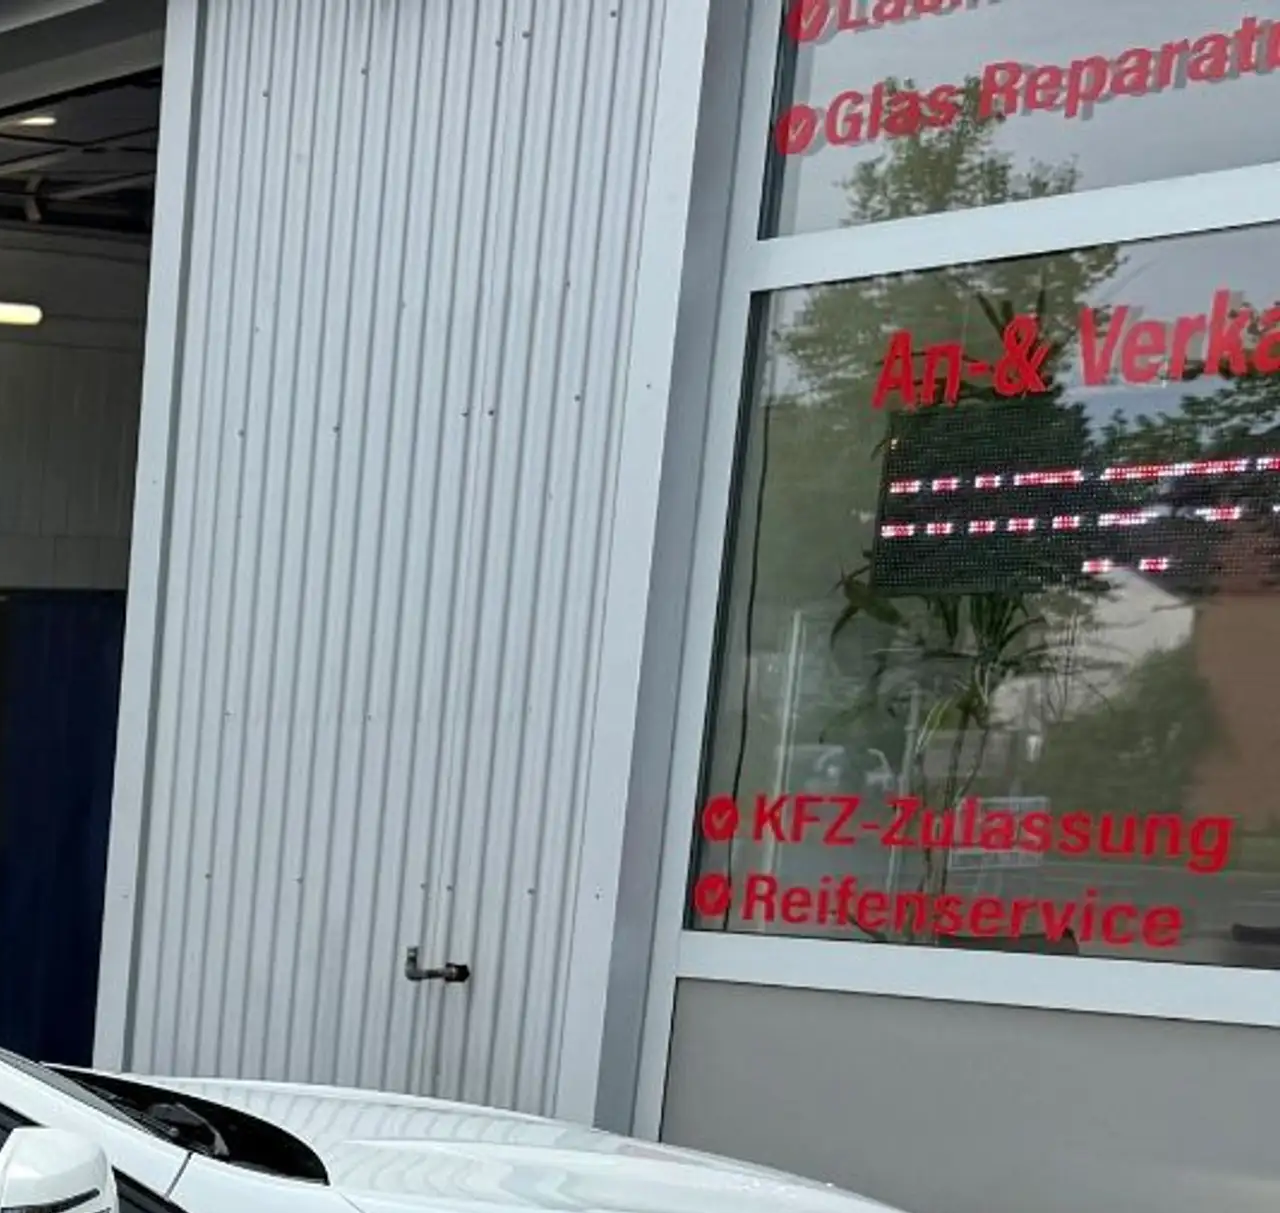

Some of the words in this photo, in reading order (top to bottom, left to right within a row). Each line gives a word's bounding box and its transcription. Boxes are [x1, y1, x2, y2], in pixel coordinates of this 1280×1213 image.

[824, 80, 963, 147] Glas
[752, 794, 1237, 875] KFZ-Zulassung
[742, 873, 1185, 949] Reifenservice
